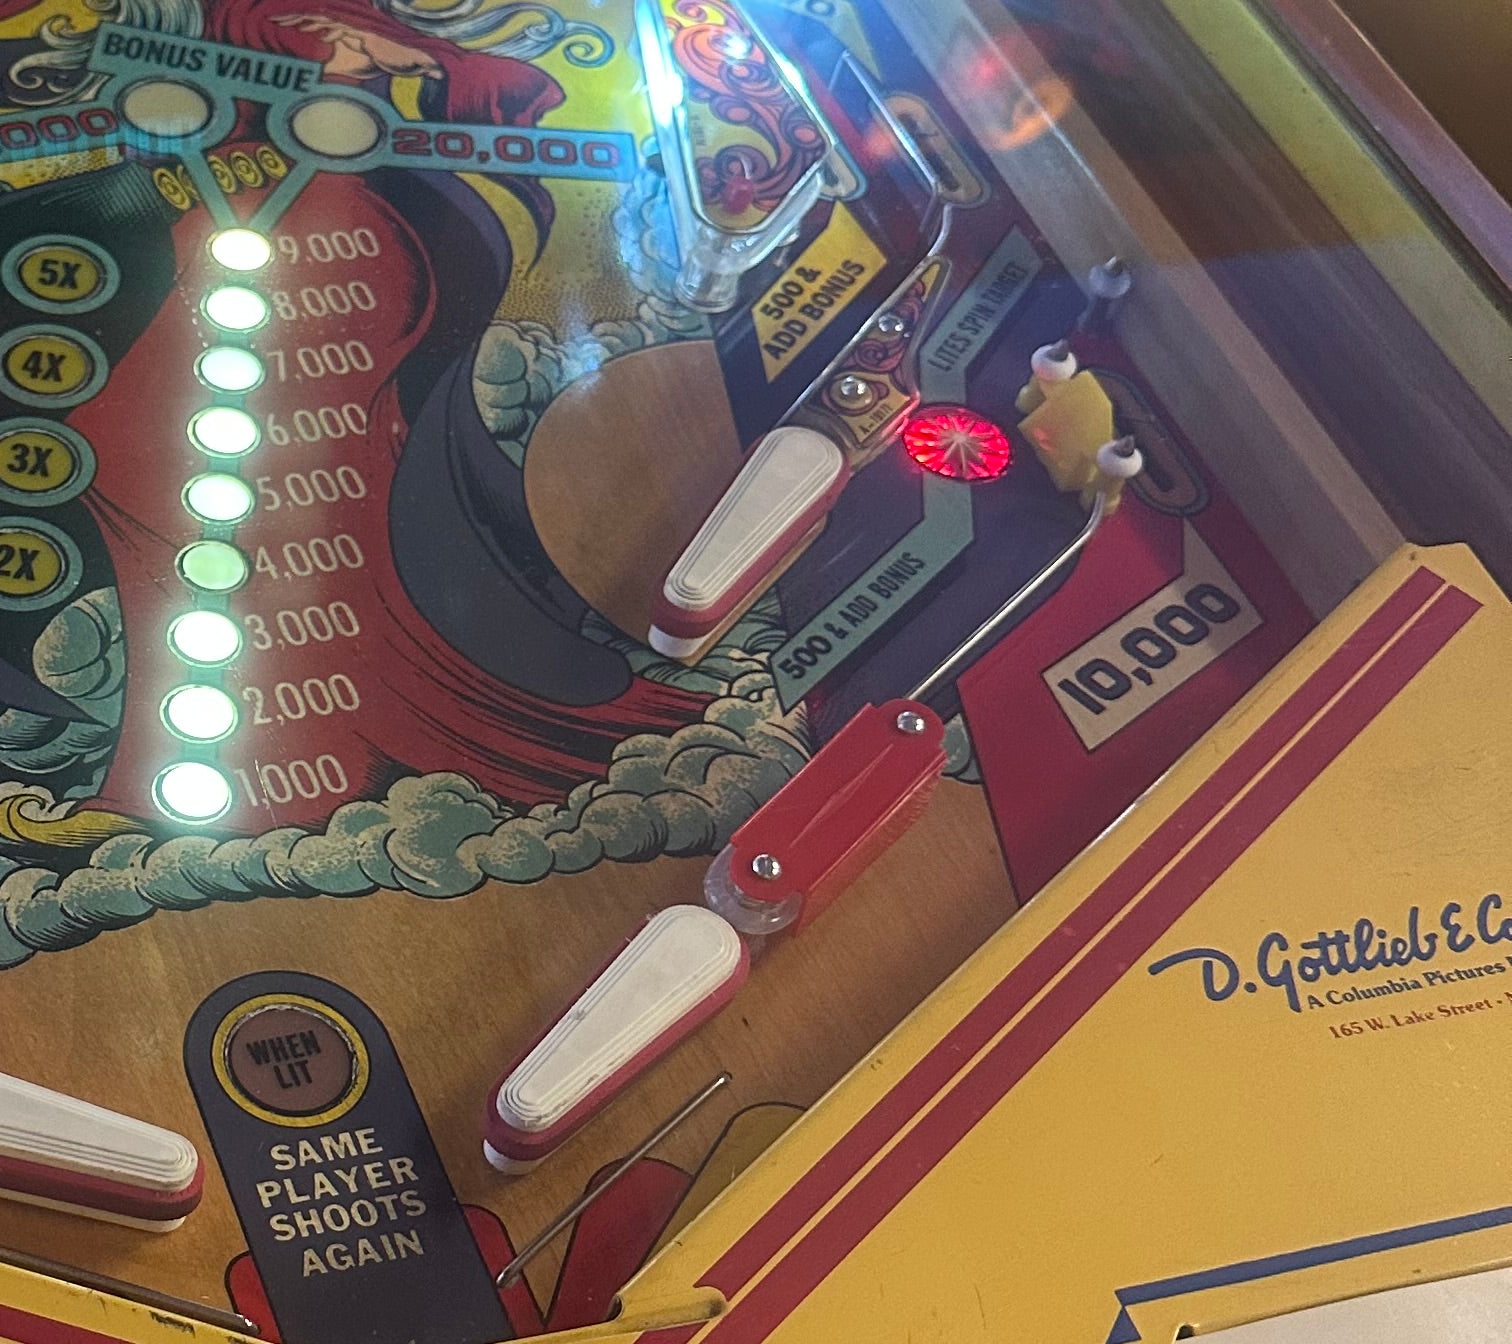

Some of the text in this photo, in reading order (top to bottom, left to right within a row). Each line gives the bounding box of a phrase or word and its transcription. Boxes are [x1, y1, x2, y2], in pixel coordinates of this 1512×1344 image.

[102, 30, 317, 94] BONUS VALUE
[391, 127, 622, 169] 20,000
[37, 258, 83, 291] 5X
[759, 264, 822, 322] 500 &
[762, 258, 867, 361] ADD BONUS
[932, 329, 973, 373] LITES
[964, 297, 993, 335] SPIN
[21, 350, 67, 383] 4X
[264, 339, 375, 383] 7,000
[6, 442, 54, 478] 3X
[256, 465, 367, 513] 5,000
[253, 533, 365, 582] 4,000
[243, 600, 361, 652] 3,000
[778, 550, 927, 682] 500 & ADD BONUS
[1056, 582, 1243, 716] 10,000
[242, 672, 361, 726] 2,000
[233, 753, 350, 811] 1,000
[1255, 906, 1439, 1014] Gottlieb
[1306, 959, 1507, 1010] A Columbia Pictures
[1328, 1020, 1364, 1040] 165
[1390, 1008, 1436, 1029] Lake
[1436, 997, 1495, 1020] Street
[245, 1029, 322, 1067] WHEN
[272, 1058, 311, 1090] LIT
[268, 1126, 384, 1172] SAME
[255, 1155, 420, 1209] PLAYER
[268, 1189, 427, 1243] SHOOTS
[301, 1228, 426, 1278] AGAIN
